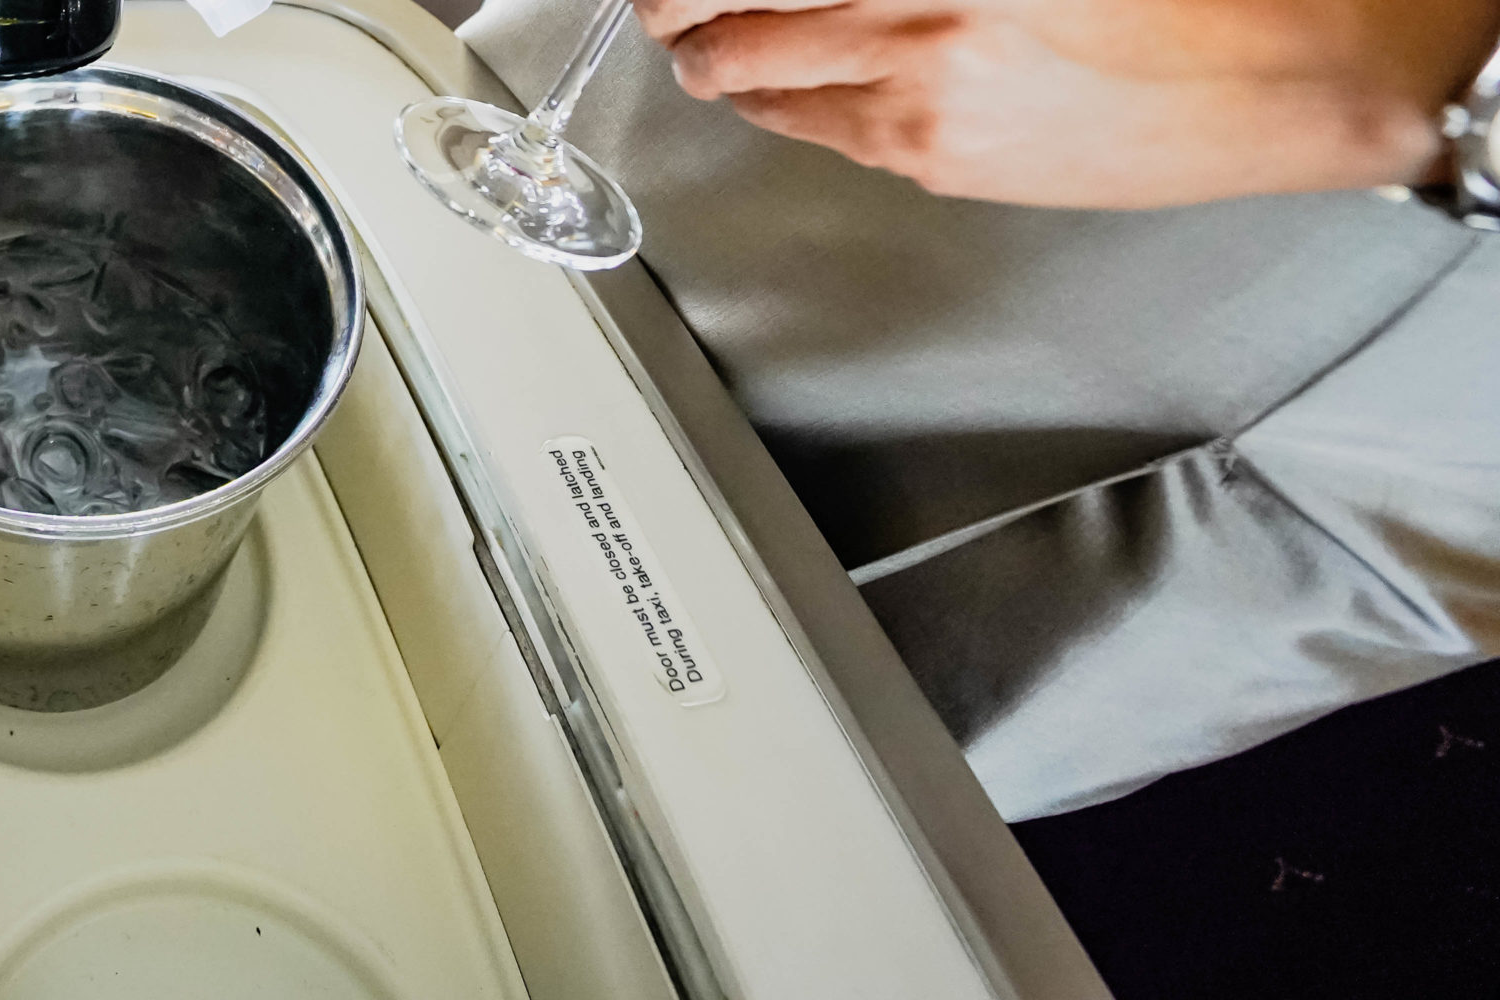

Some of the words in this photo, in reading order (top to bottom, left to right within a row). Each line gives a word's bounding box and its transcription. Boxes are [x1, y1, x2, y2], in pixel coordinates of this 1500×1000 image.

[549, 449, 584, 499] latched
[572, 449, 604, 500] landing
[576, 502, 600, 529] and
[597, 502, 621, 530] and
[592, 533, 627, 581] closed
[613, 533, 653, 589] take-off
[622, 585, 640, 605] be
[649, 592, 672, 625] taxi,
[633, 607, 661, 647] must
[656, 651, 685, 692] Door
[667, 628, 703, 683] During
